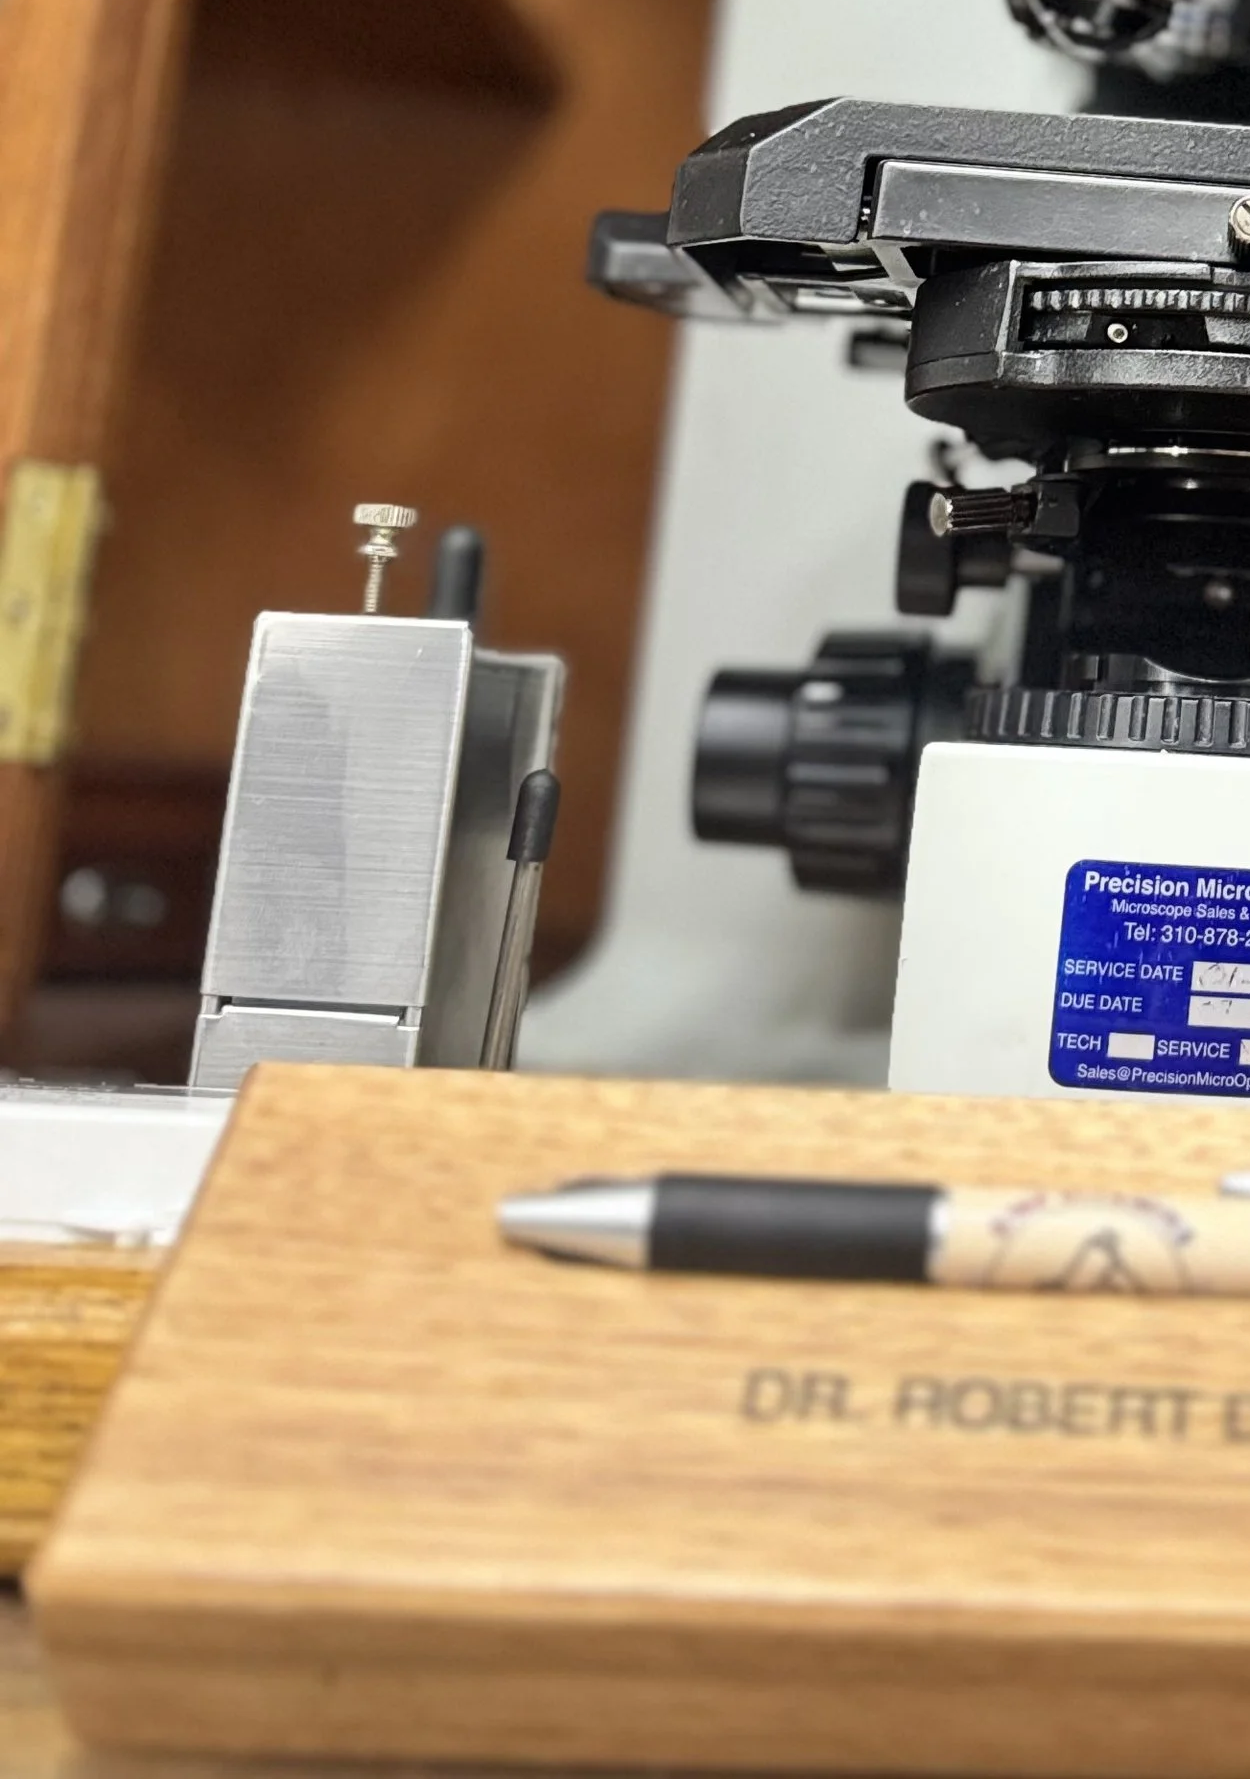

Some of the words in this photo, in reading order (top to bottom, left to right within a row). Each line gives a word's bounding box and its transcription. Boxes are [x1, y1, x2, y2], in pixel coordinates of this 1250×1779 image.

[1084, 870, 1189, 898] Precision
[1112, 899, 1192, 920] Microscope
[1196, 904, 1236, 920] Sales
[1240, 906, 1250, 921] &
[1124, 921, 1156, 942] Tel:
[1064, 958, 1136, 979] SERVICE
[1140, 964, 1184, 982] DATE
[1061, 992, 1096, 1009] DUE
[1100, 994, 1143, 1013] DATE
[1057, 1032, 1102, 1051] TECH
[1156, 1039, 1231, 1059] SERVICE
[740, 1367, 862, 1425] DR.
[892, 1374, 1196, 1443] ROBERT
